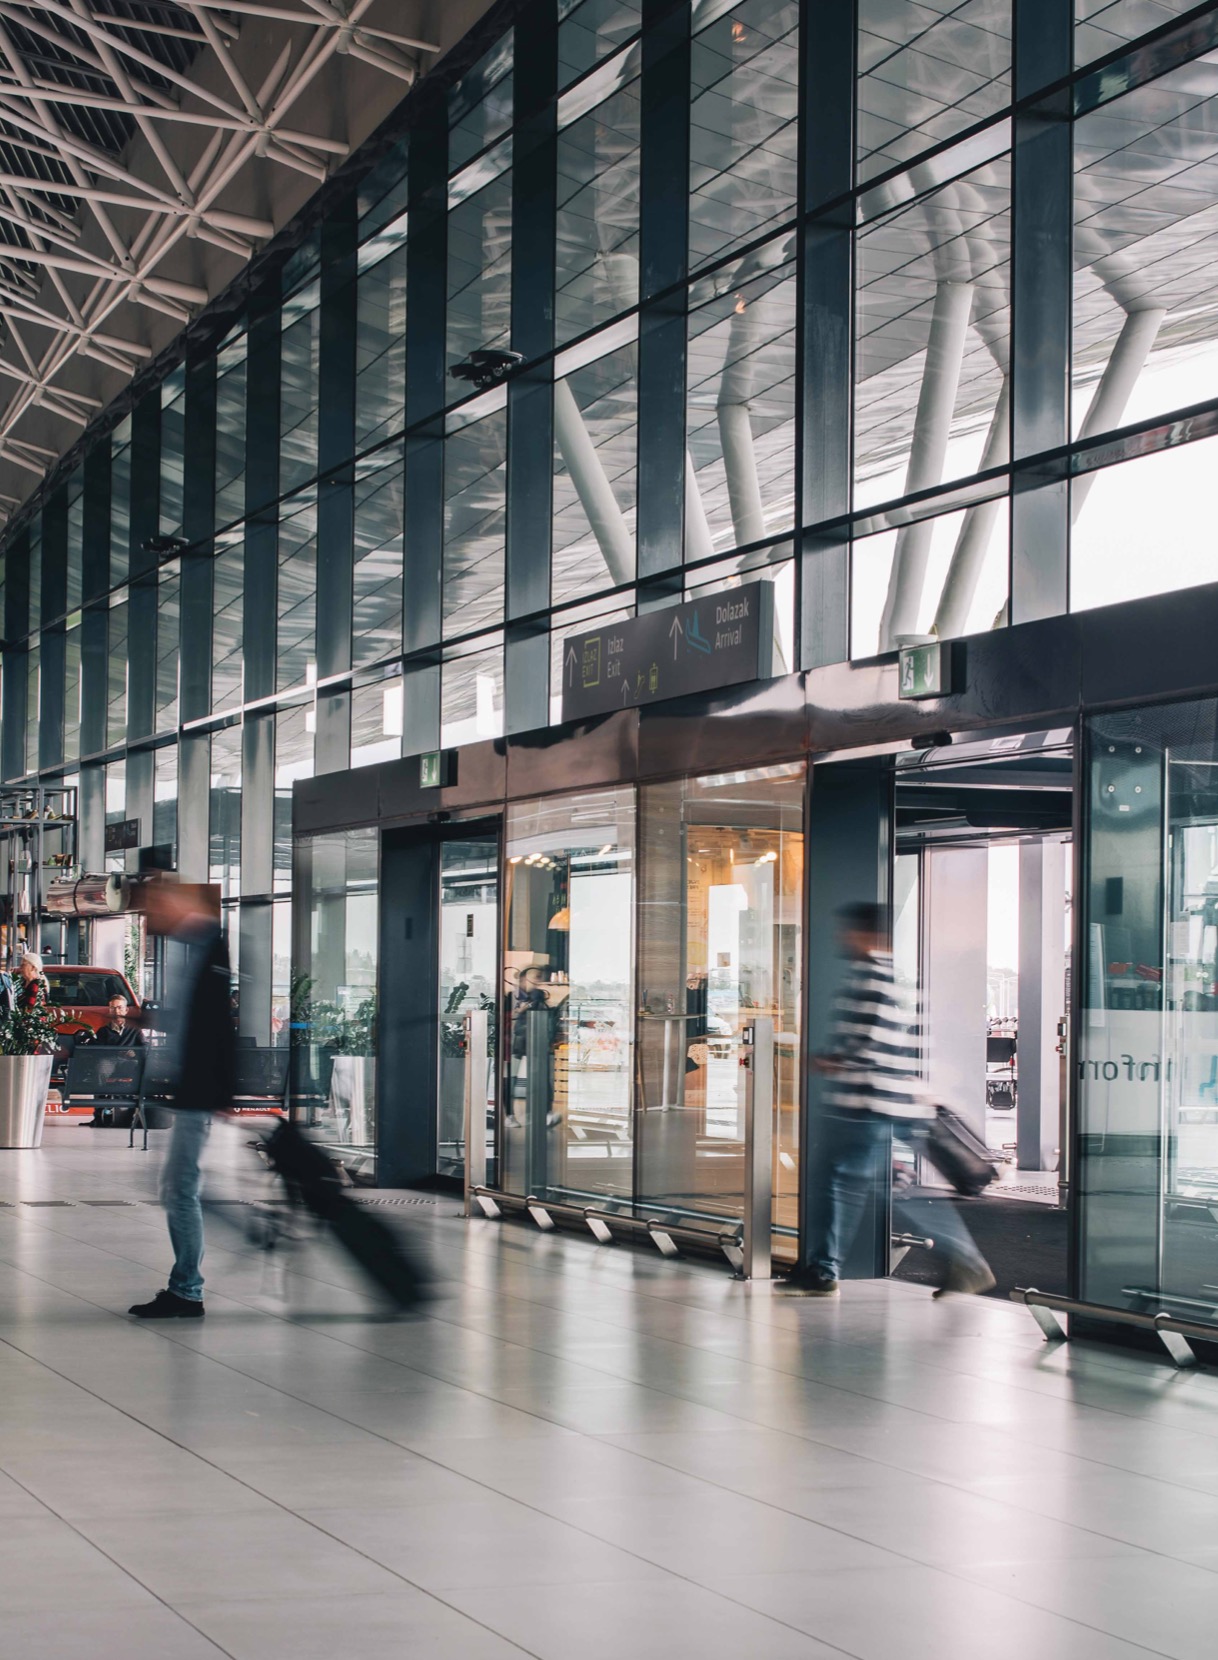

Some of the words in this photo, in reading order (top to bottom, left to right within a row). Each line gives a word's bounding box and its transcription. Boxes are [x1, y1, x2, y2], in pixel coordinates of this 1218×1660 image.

[715, 597, 749, 624] Dolazak
[607, 635, 624, 655] Izlaz
[715, 625, 742, 650] Arrival
[582, 648, 597, 663] IZLAZ
[582, 663, 594, 678] EXIT
[607, 659, 621, 678] Exit
